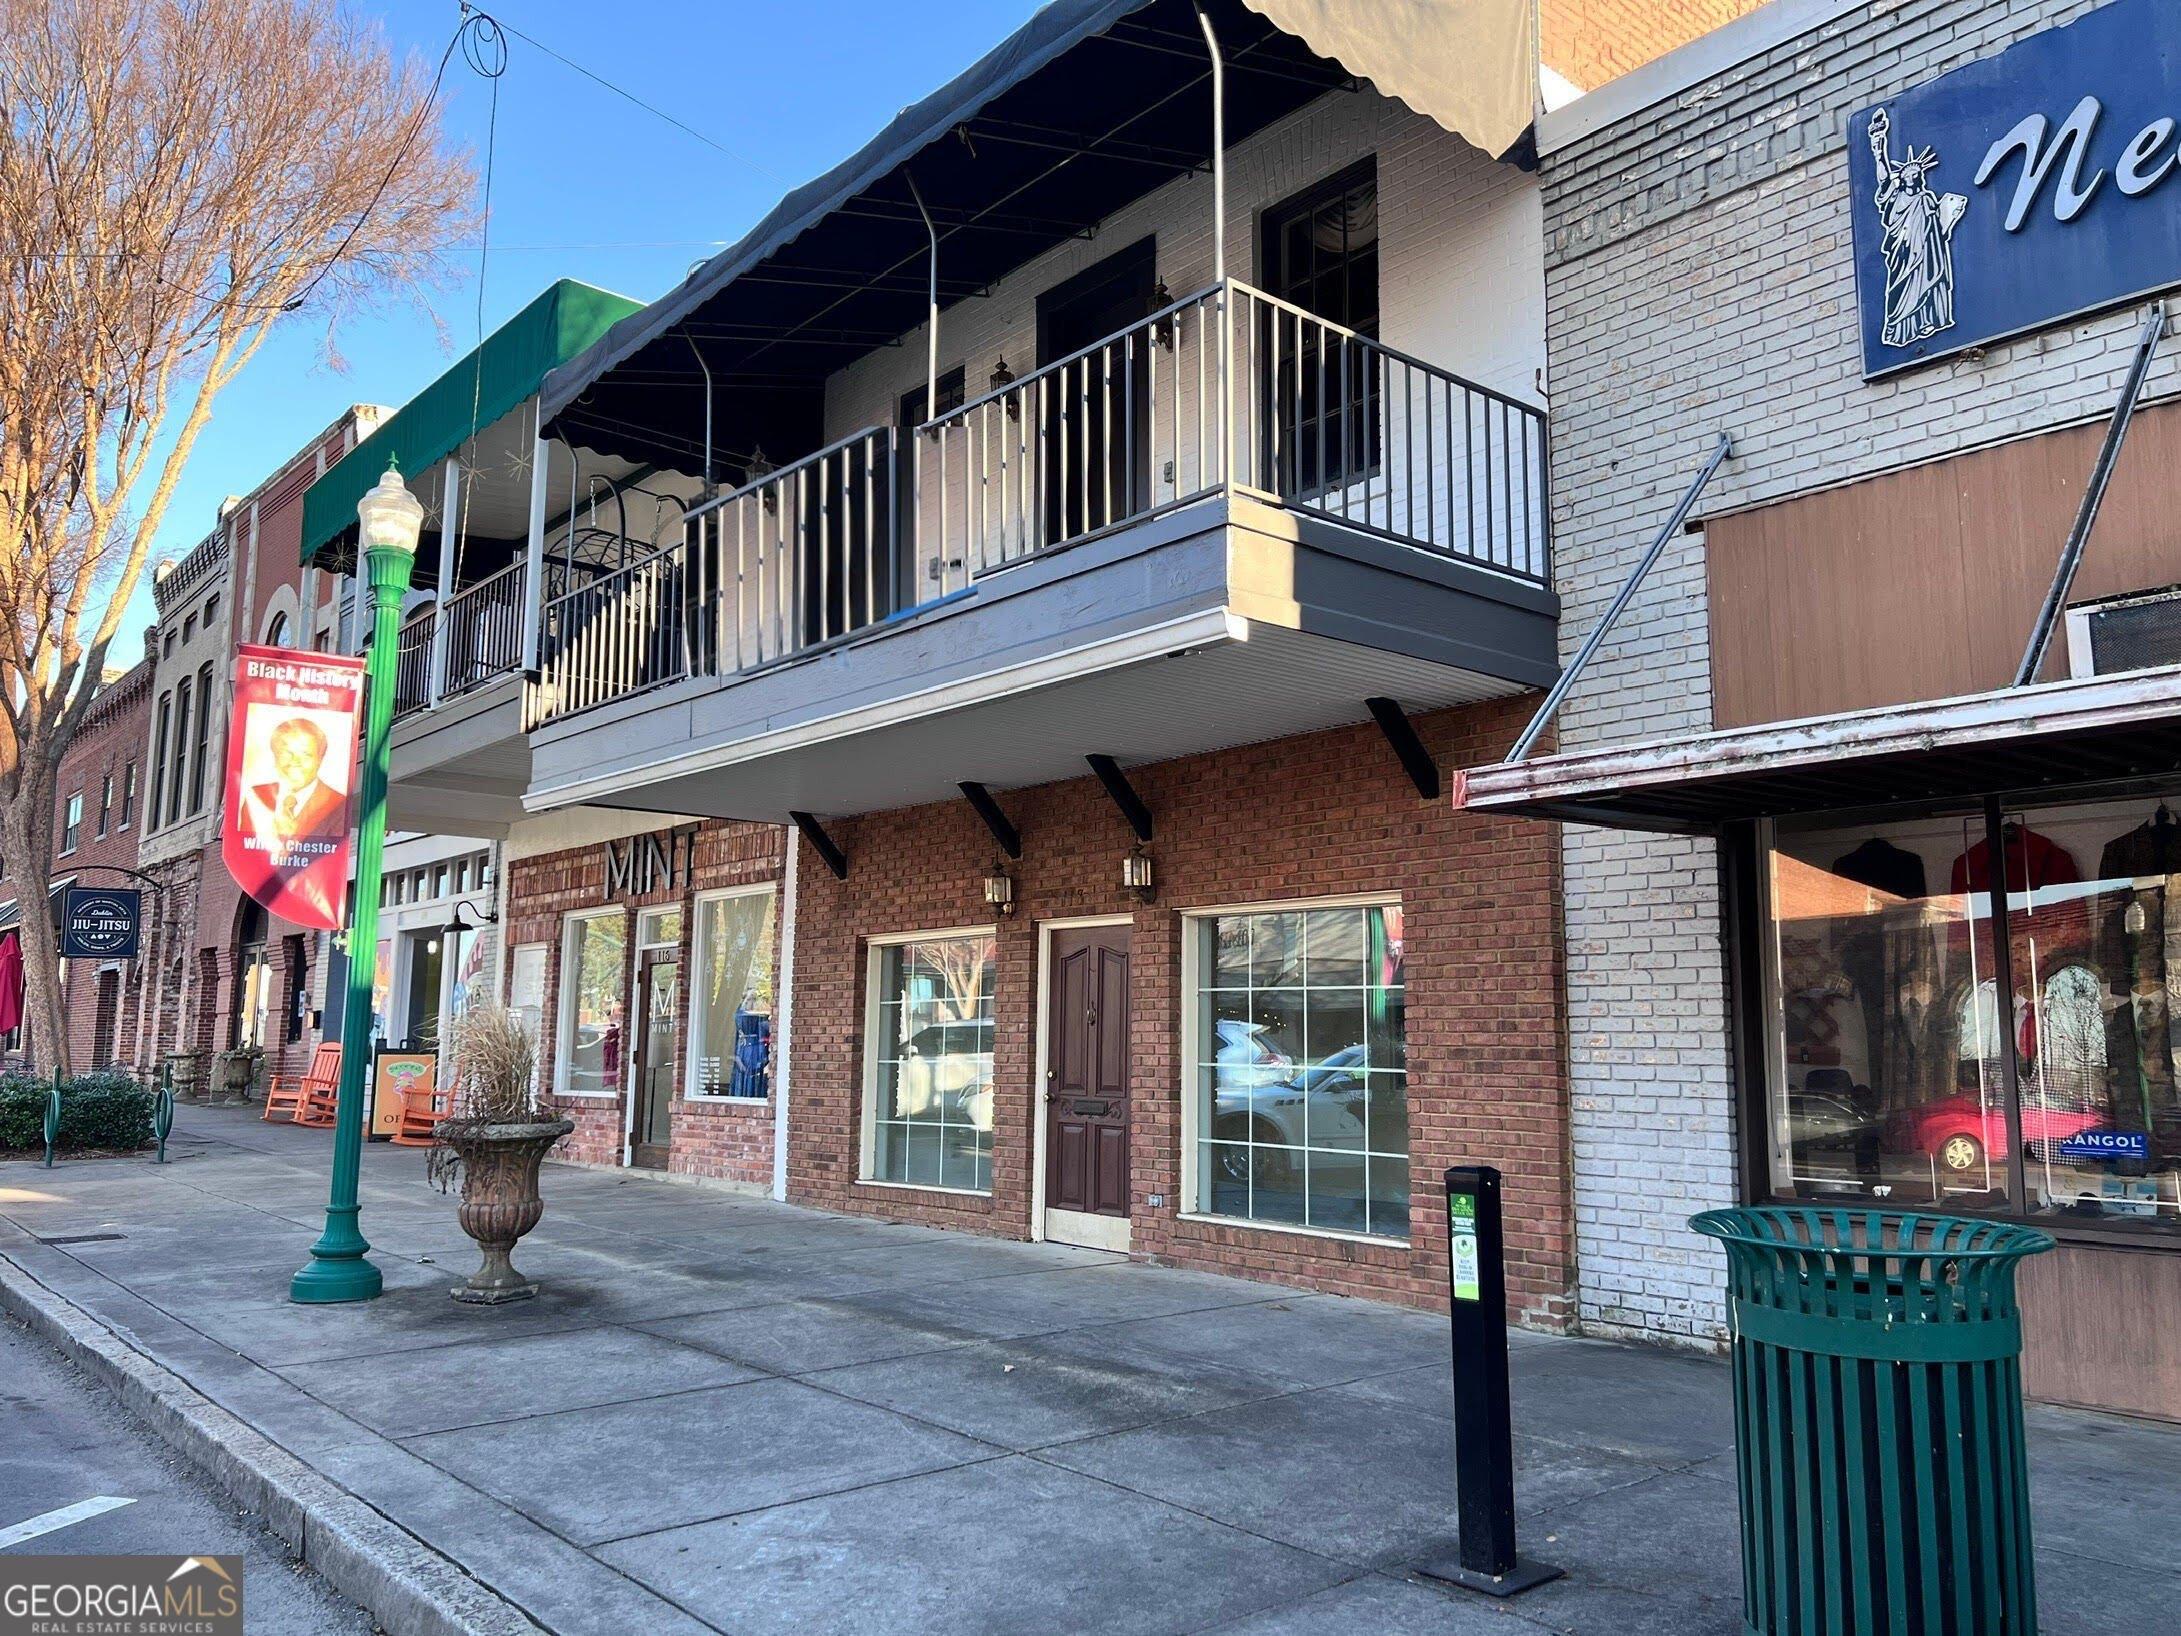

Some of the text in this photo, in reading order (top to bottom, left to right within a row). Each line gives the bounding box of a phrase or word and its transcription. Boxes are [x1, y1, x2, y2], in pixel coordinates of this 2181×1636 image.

[1974, 95, 2181, 231] Ne
[247, 661, 297, 682] Black
[275, 683, 329, 704] Month
[286, 840, 337, 854] Chester
[270, 854, 309, 867] Burke
[603, 822, 698, 899] MINT
[72, 919, 131, 931] JIU-JITSU
[651, 1023, 674, 1033] MINT
